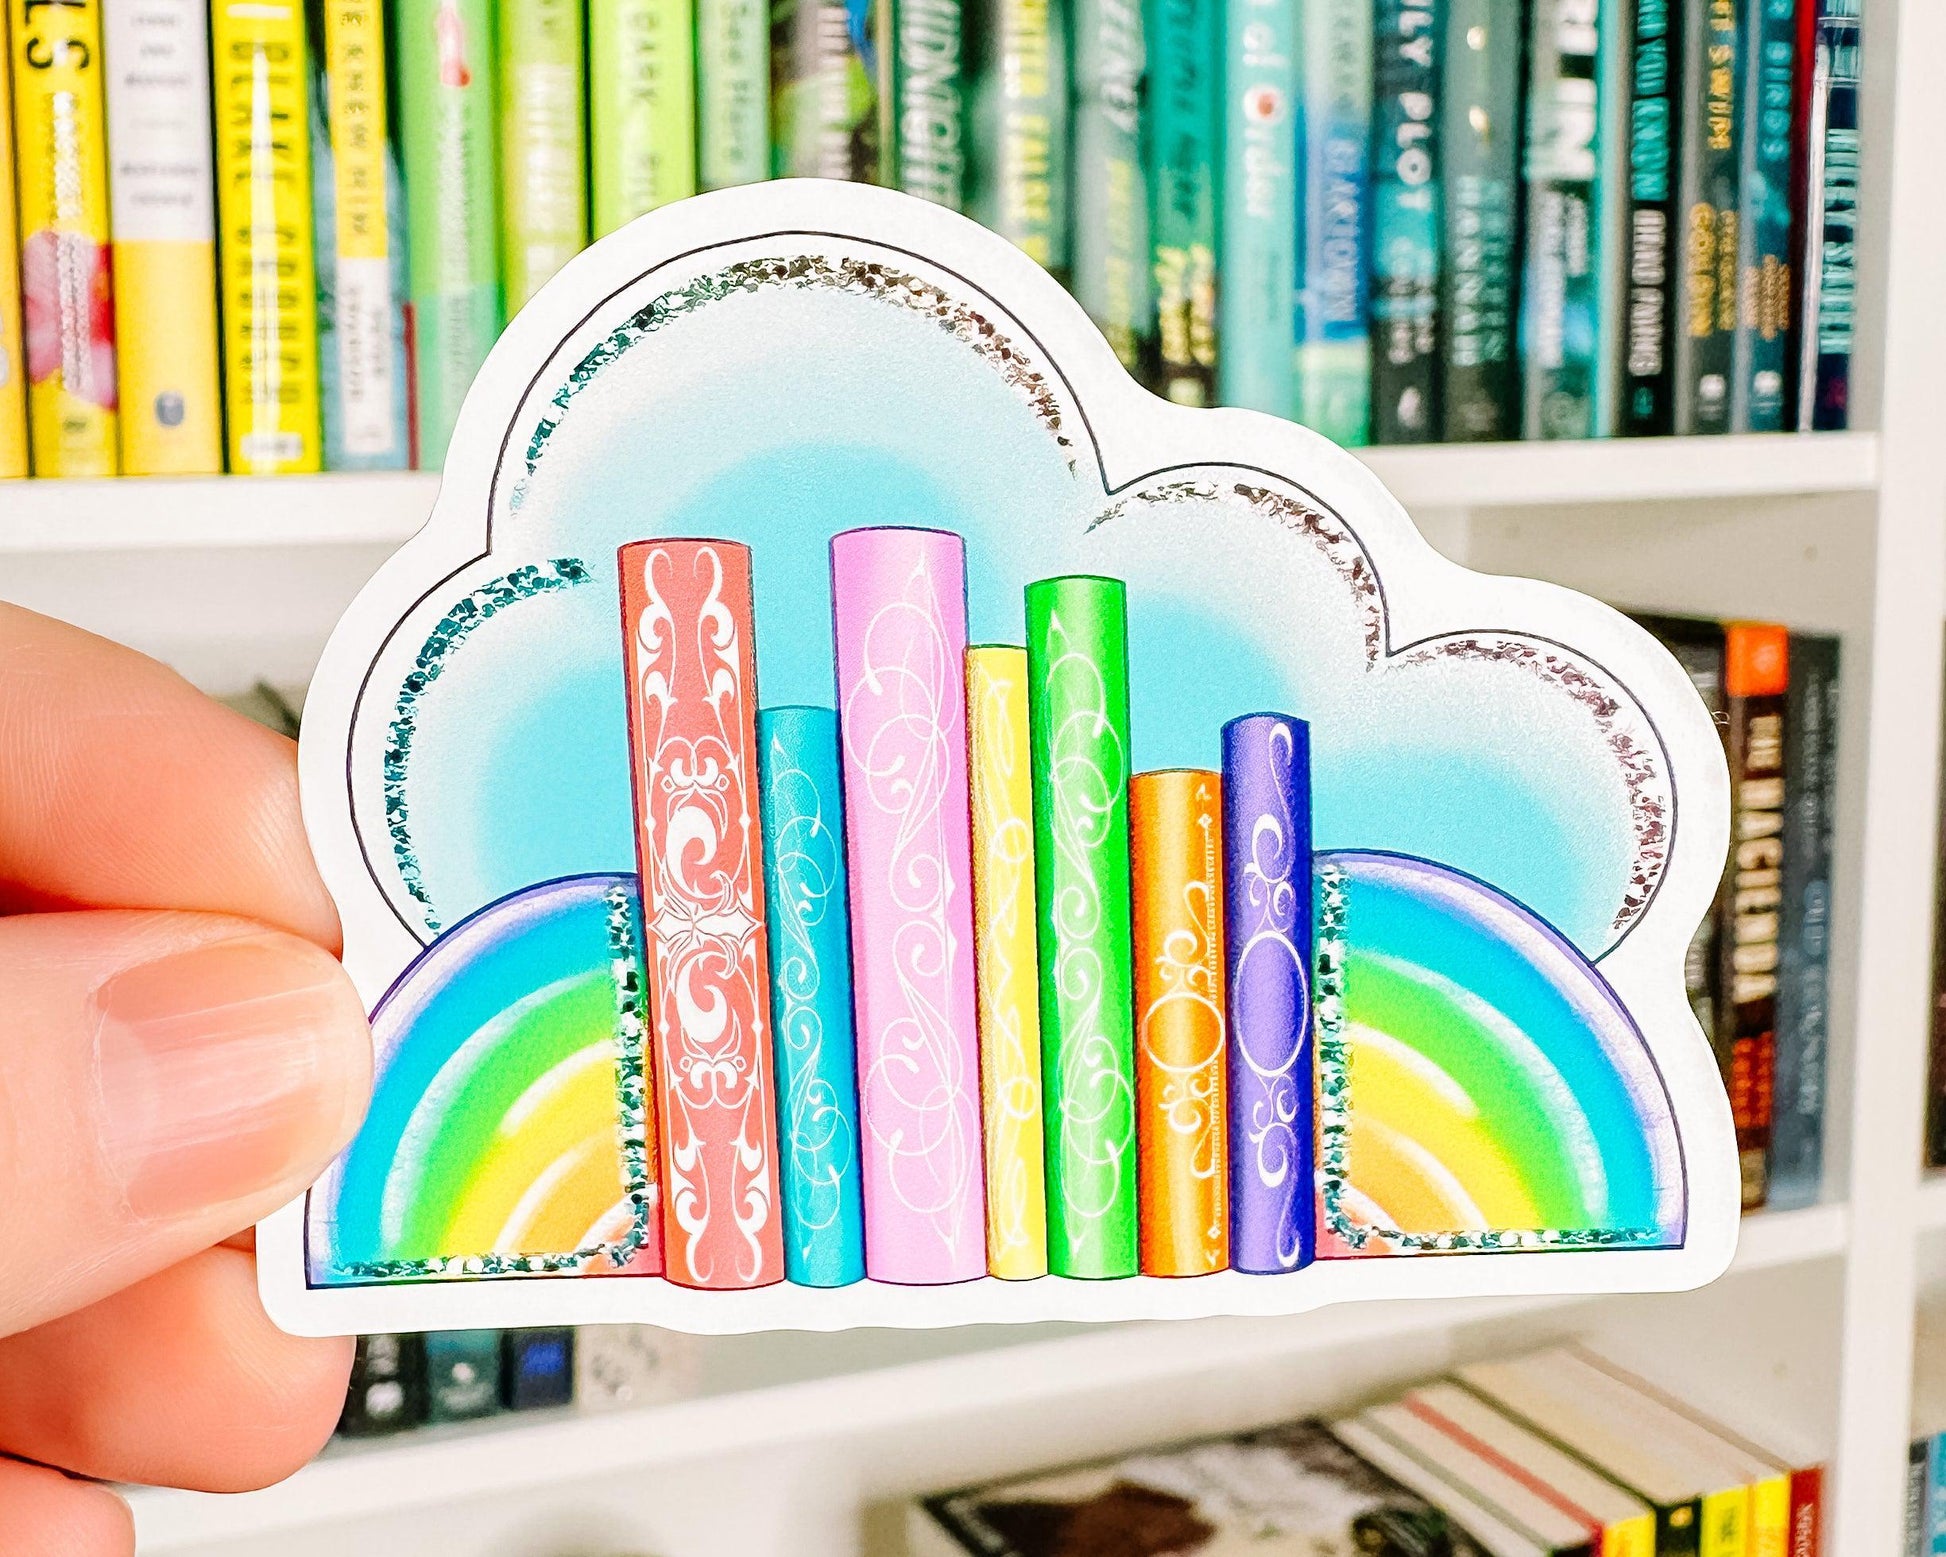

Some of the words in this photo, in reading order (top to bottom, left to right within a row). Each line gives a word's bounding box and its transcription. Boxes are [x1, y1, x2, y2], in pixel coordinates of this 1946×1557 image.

[231, 40, 296, 187] BLAKE
[1396, 90, 1436, 212] PLOT
[237, 225, 302, 404] CROUCH
[1733, 777, 1784, 1004] HACIENDA
